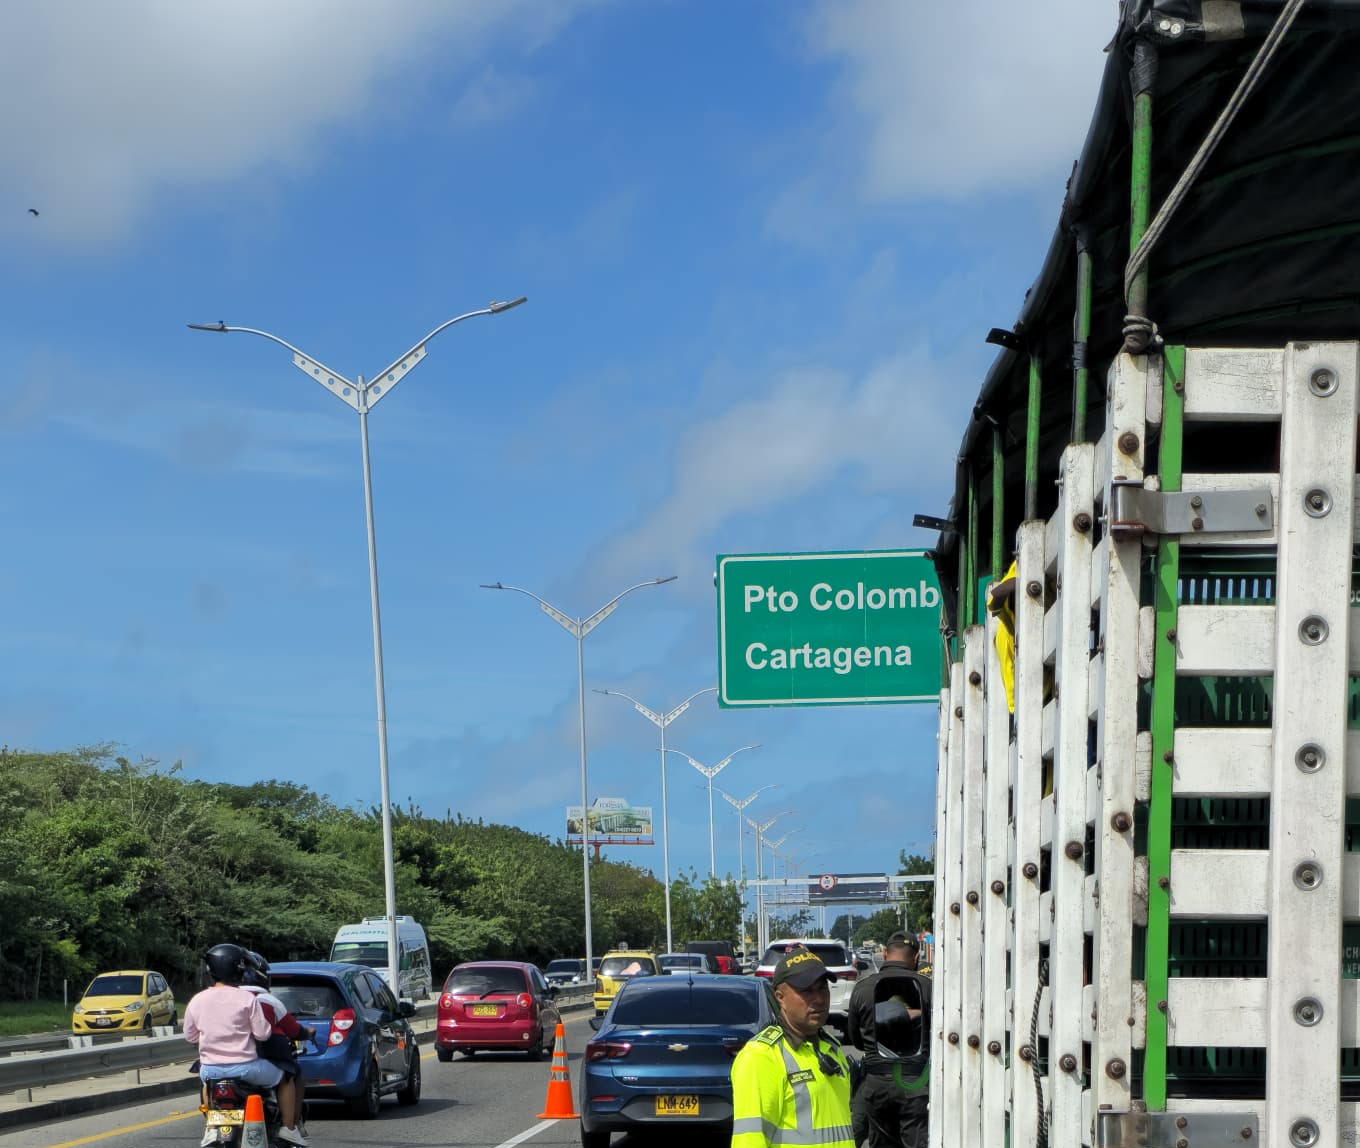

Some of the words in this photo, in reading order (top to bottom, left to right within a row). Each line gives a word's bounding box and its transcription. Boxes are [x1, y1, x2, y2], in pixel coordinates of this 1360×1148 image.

[744, 585, 799, 613] Pto
[809, 580, 939, 611] Colomb
[745, 642, 912, 675] Cartagena
